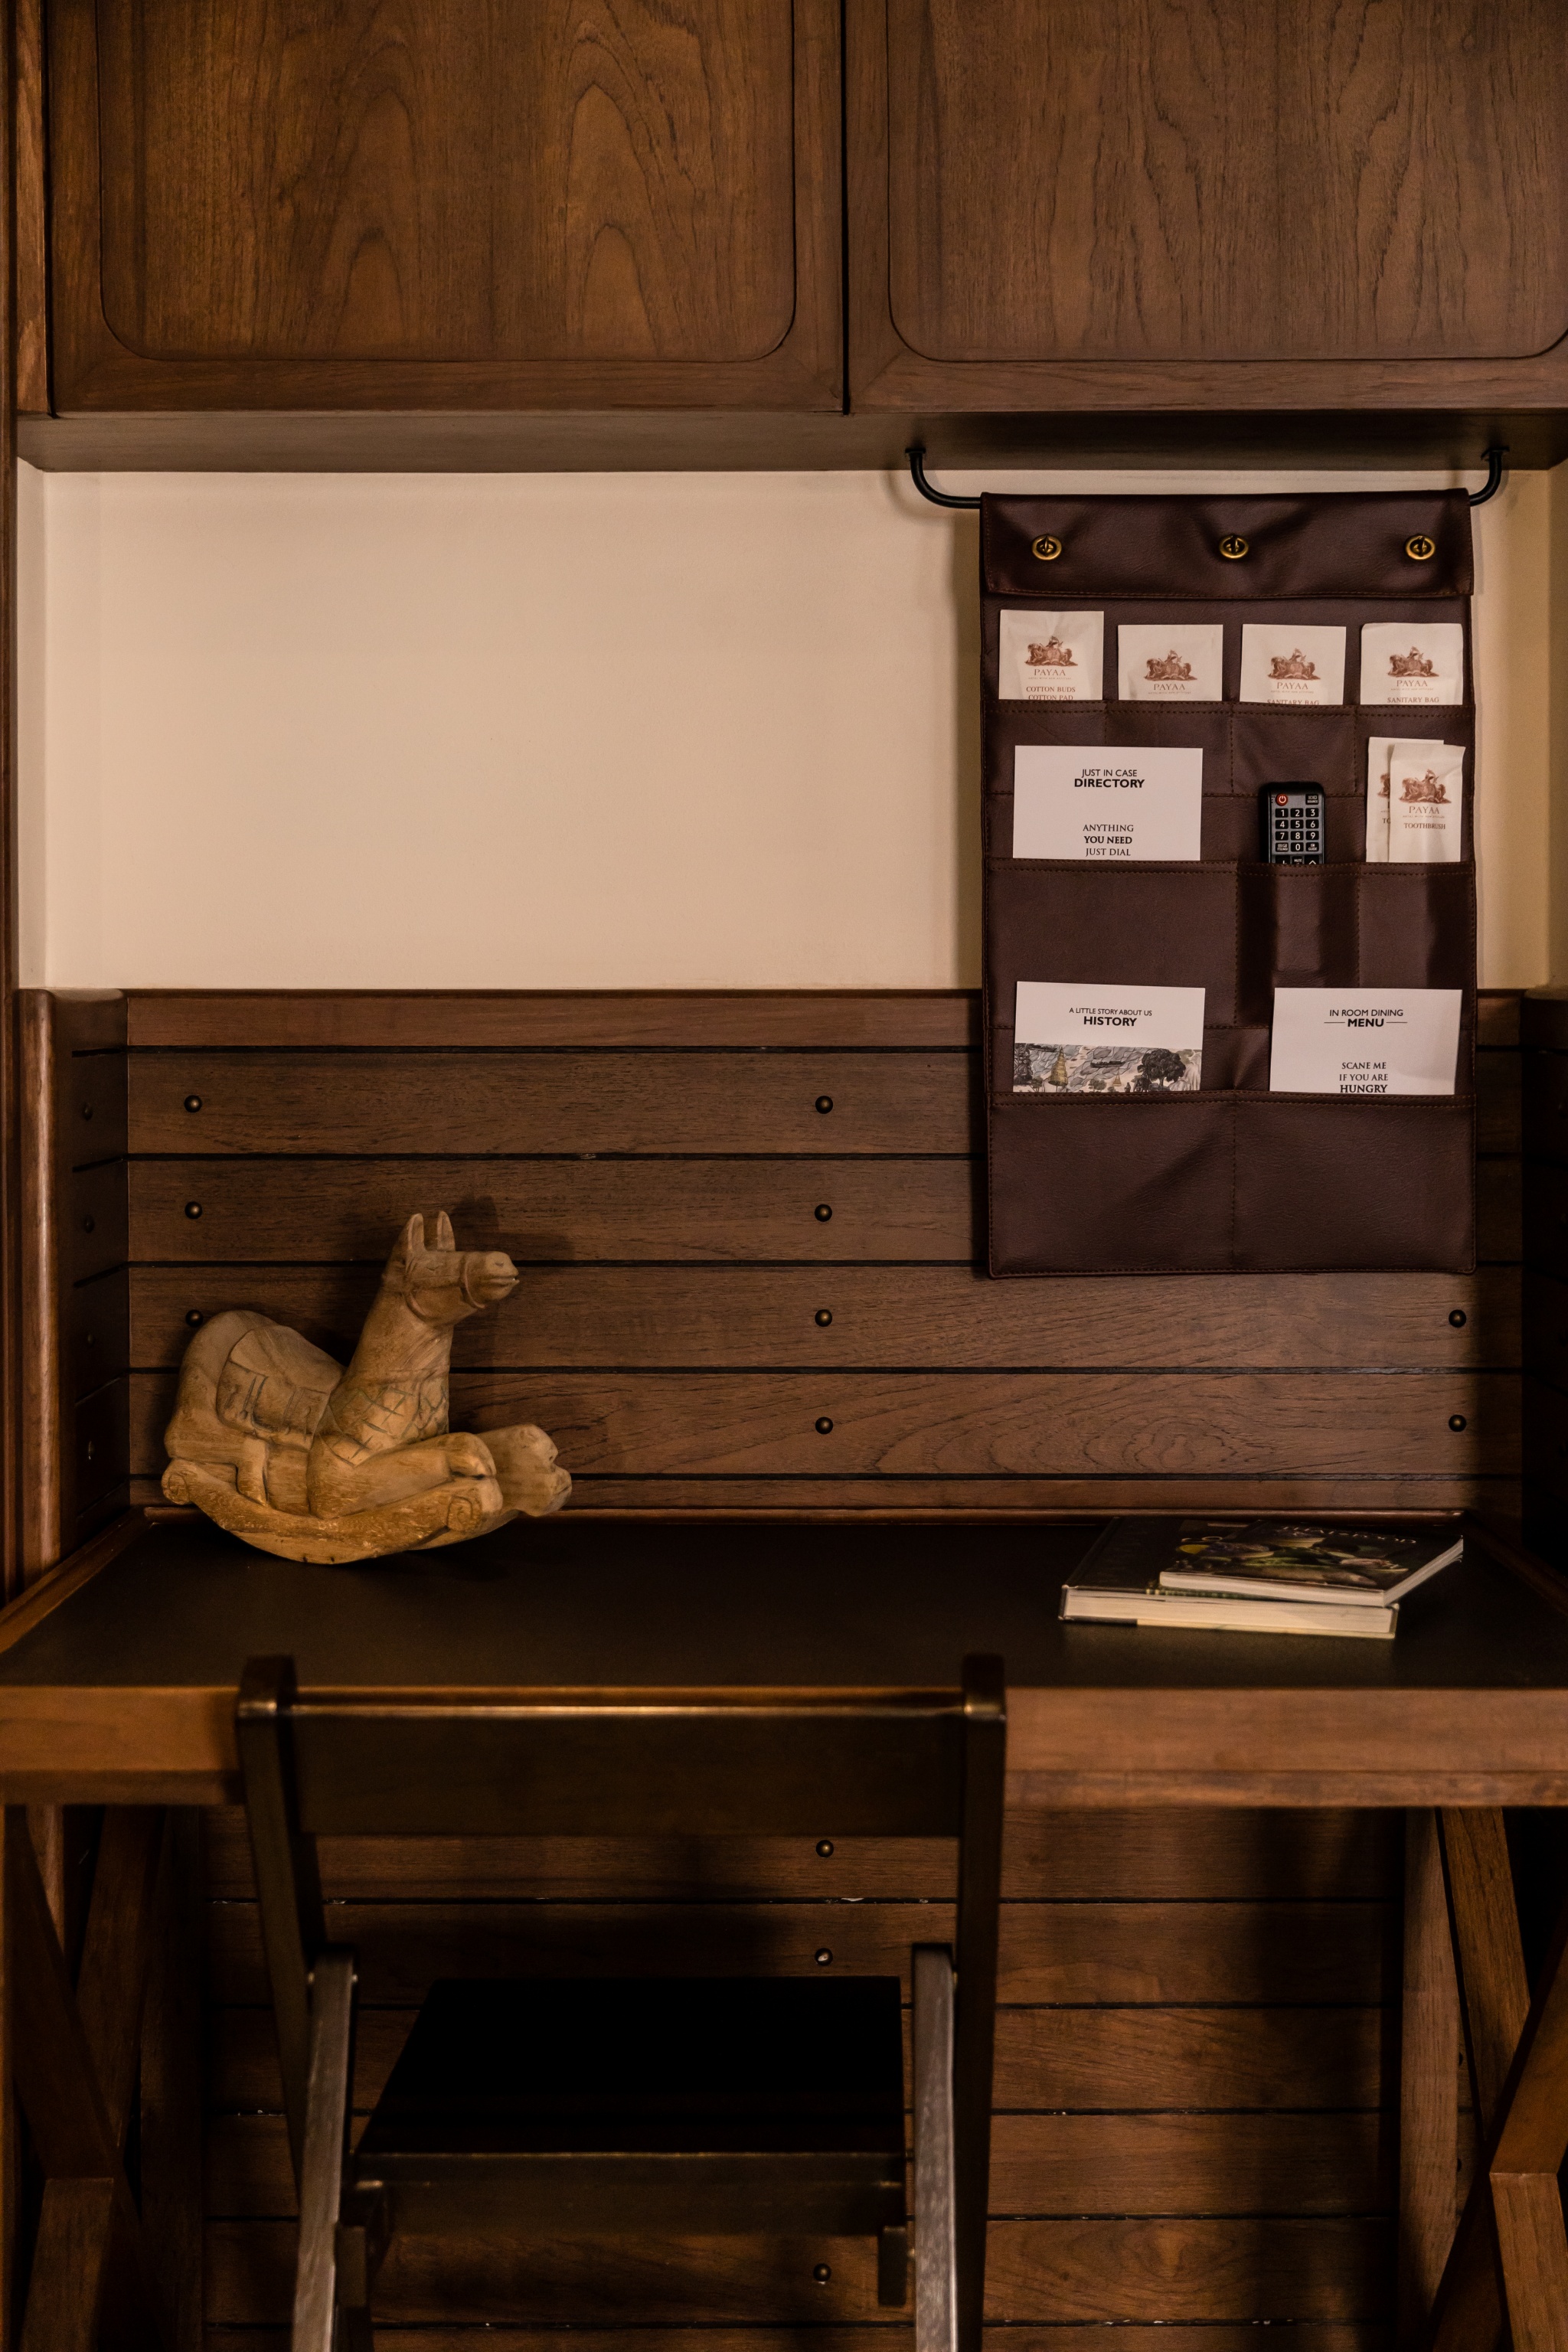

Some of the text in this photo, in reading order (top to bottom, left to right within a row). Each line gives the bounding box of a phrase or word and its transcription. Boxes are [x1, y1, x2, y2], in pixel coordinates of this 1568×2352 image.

[1081, 769, 1101, 778] JUST
[1074, 778, 1145, 788] DIRECTORY
[1083, 835, 1104, 844] YOU
[1086, 848, 1106, 857] JUST
[1083, 1016, 1138, 1027] HISTORY
[1348, 1018, 1384, 1027] MENU
[1340, 1084, 1388, 1093] HUNGRY
